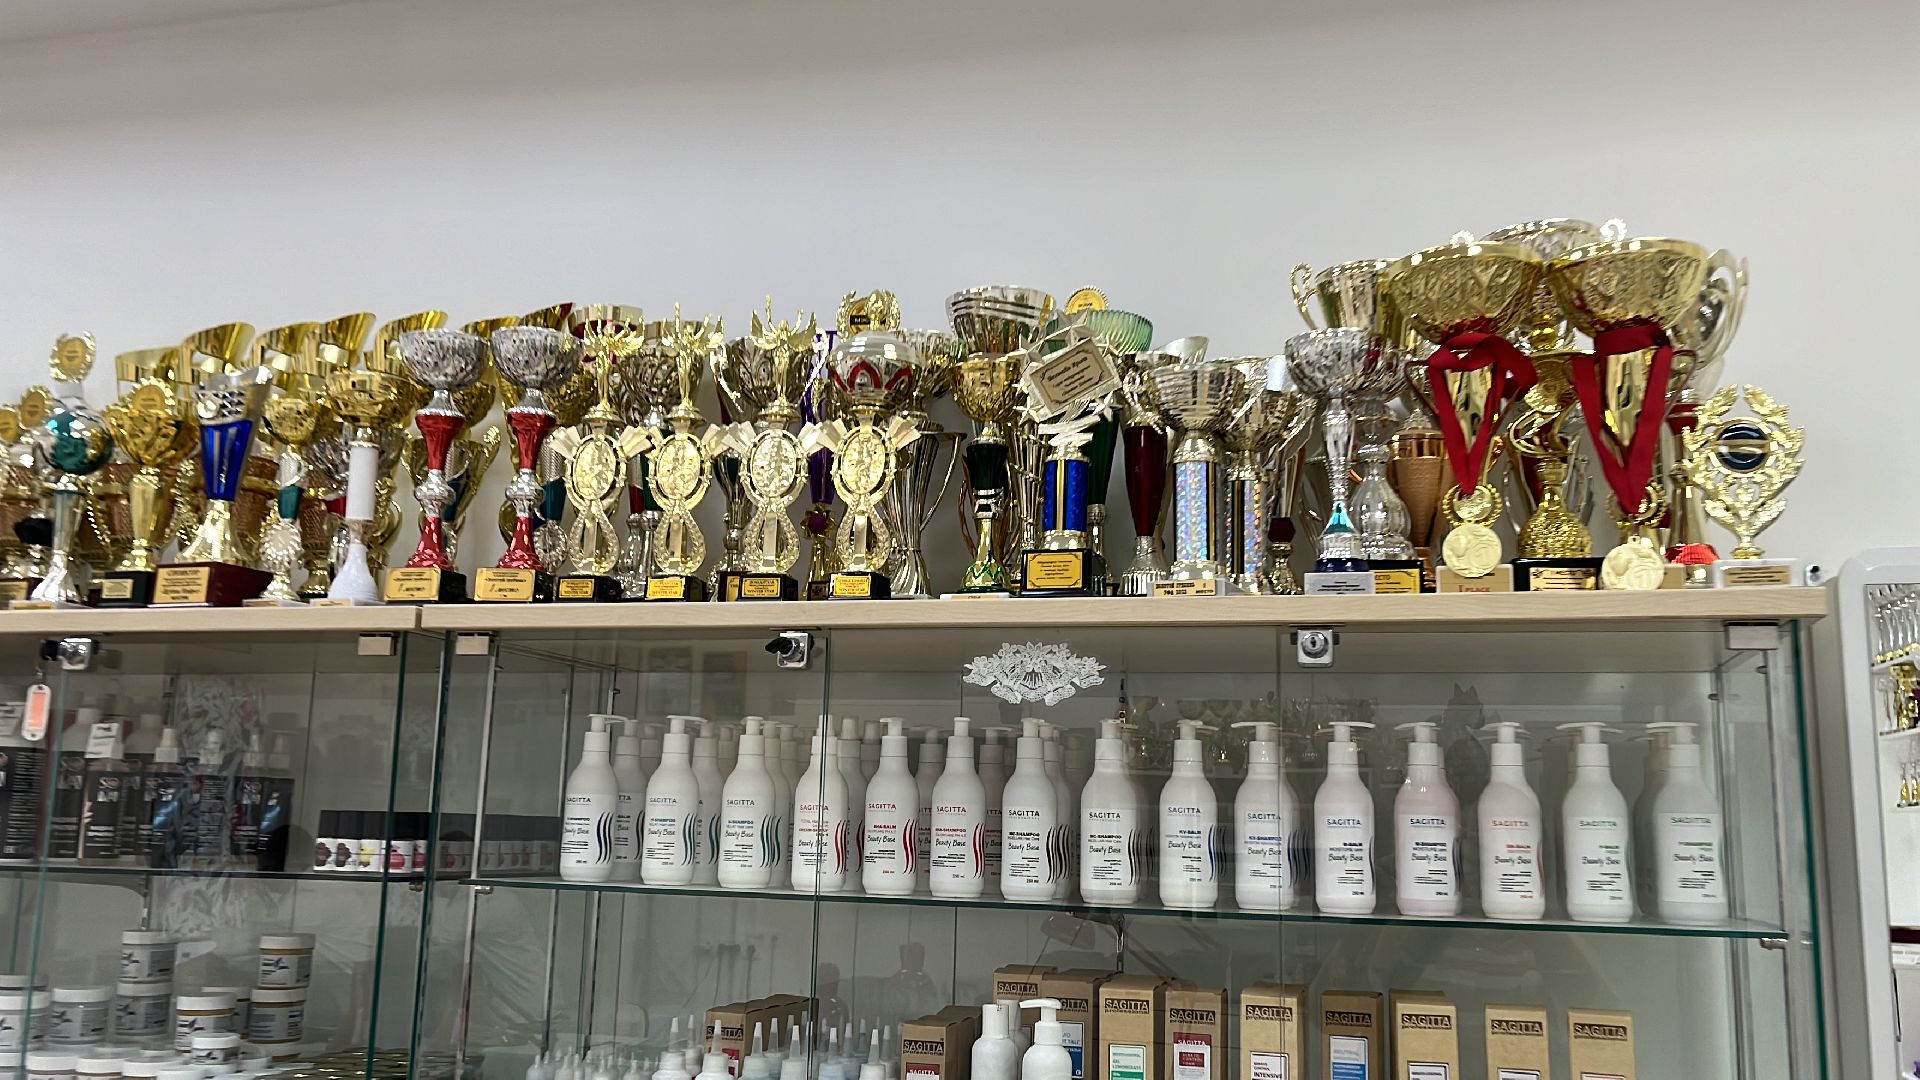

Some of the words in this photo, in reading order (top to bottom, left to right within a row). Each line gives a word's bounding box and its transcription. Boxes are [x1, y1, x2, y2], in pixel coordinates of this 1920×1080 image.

[1009, 809, 1040, 817] SAGITTA
[998, 983, 1037, 992] SAGITTA
[1105, 1000, 1149, 1011] SAGITTA
[1170, 1009, 1214, 1022] SAGITTA
[1247, 1006, 1291, 1018] SAGITTA
[1326, 1012, 1371, 1024] SAGITTA
[1402, 1015, 1450, 1027] SAGITTA
[1492, 1021, 1541, 1033] SAGITTA
[1575, 1024, 1626, 1039] SAGITTA
[904, 1041, 943, 1052] SAGITTA
